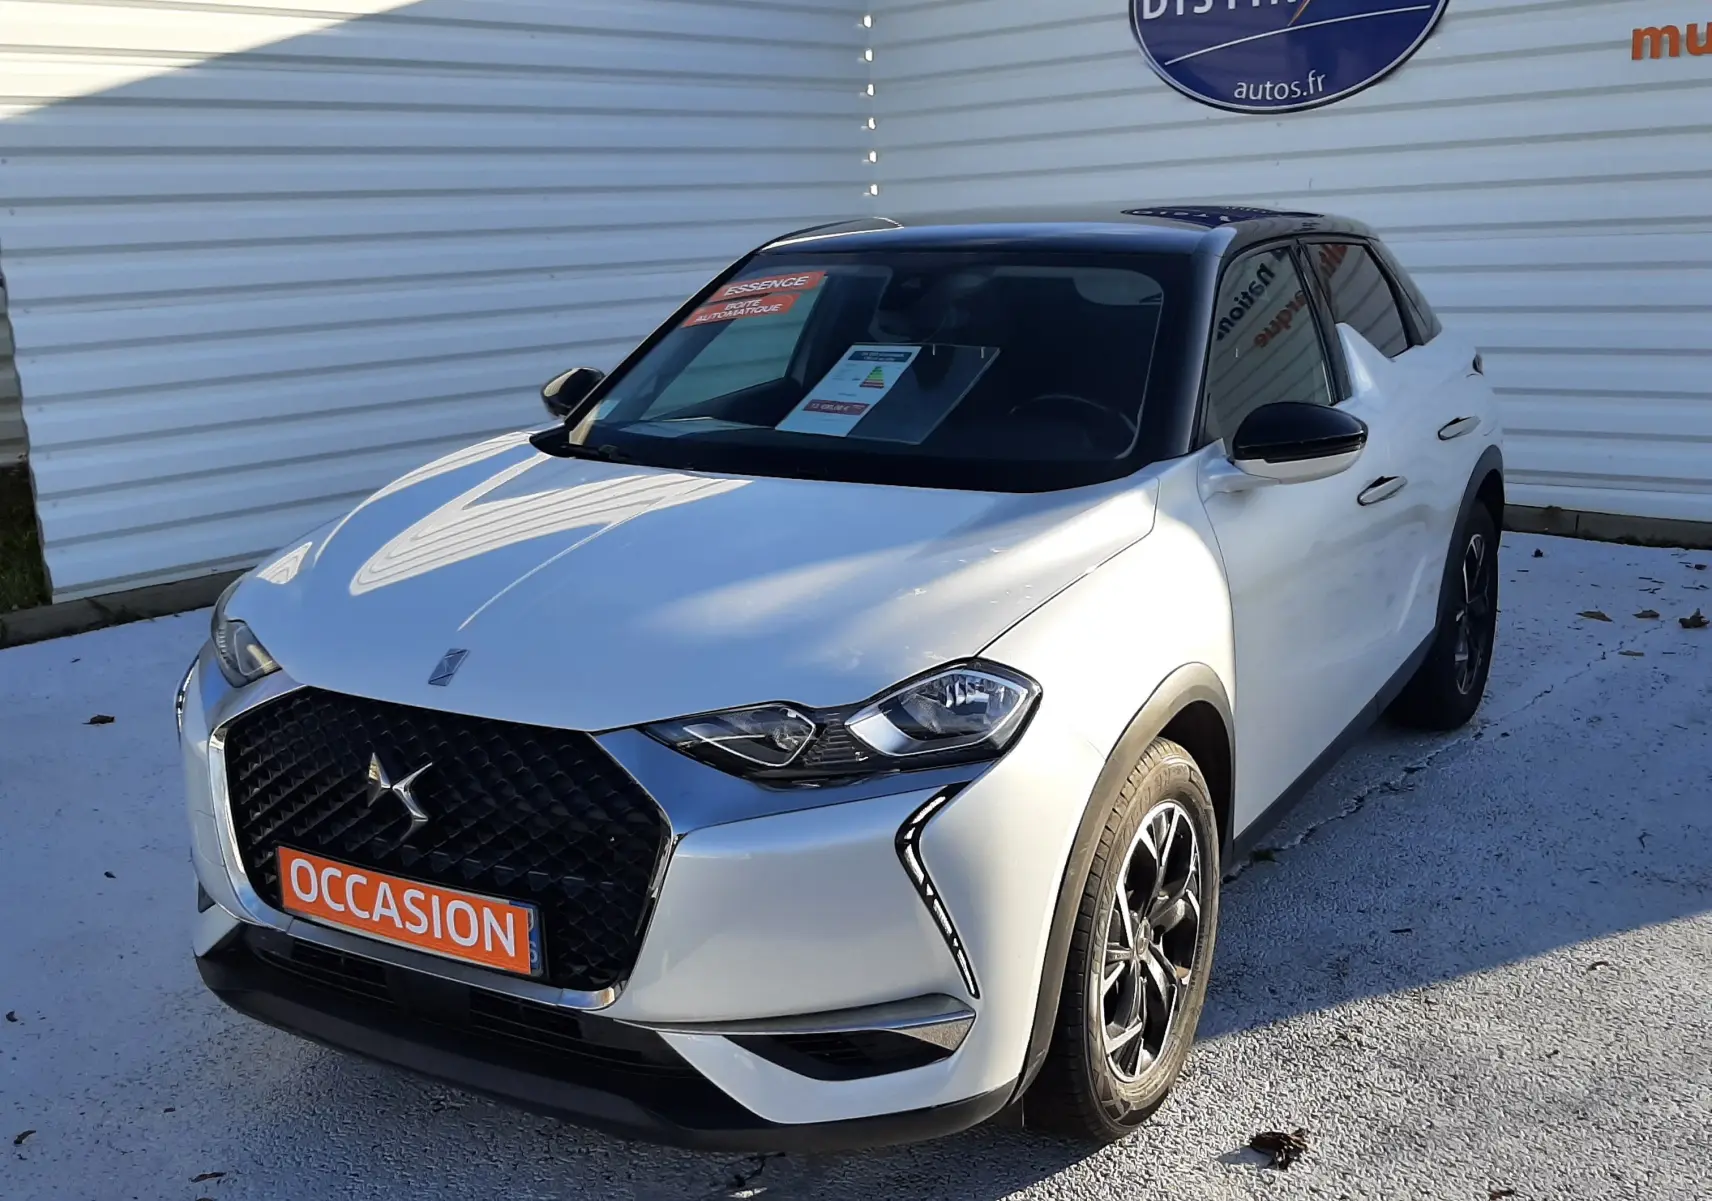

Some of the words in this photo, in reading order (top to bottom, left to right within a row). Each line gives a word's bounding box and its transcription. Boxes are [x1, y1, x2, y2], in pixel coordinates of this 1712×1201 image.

[1631, 22, 1712, 61] mu
[1233, 69, 1326, 101] autos.fr
[723, 275, 809, 297] ESSENCE
[694, 303, 783, 323] AUTOMATIQUE
[290, 857, 516, 958] OCCASION
